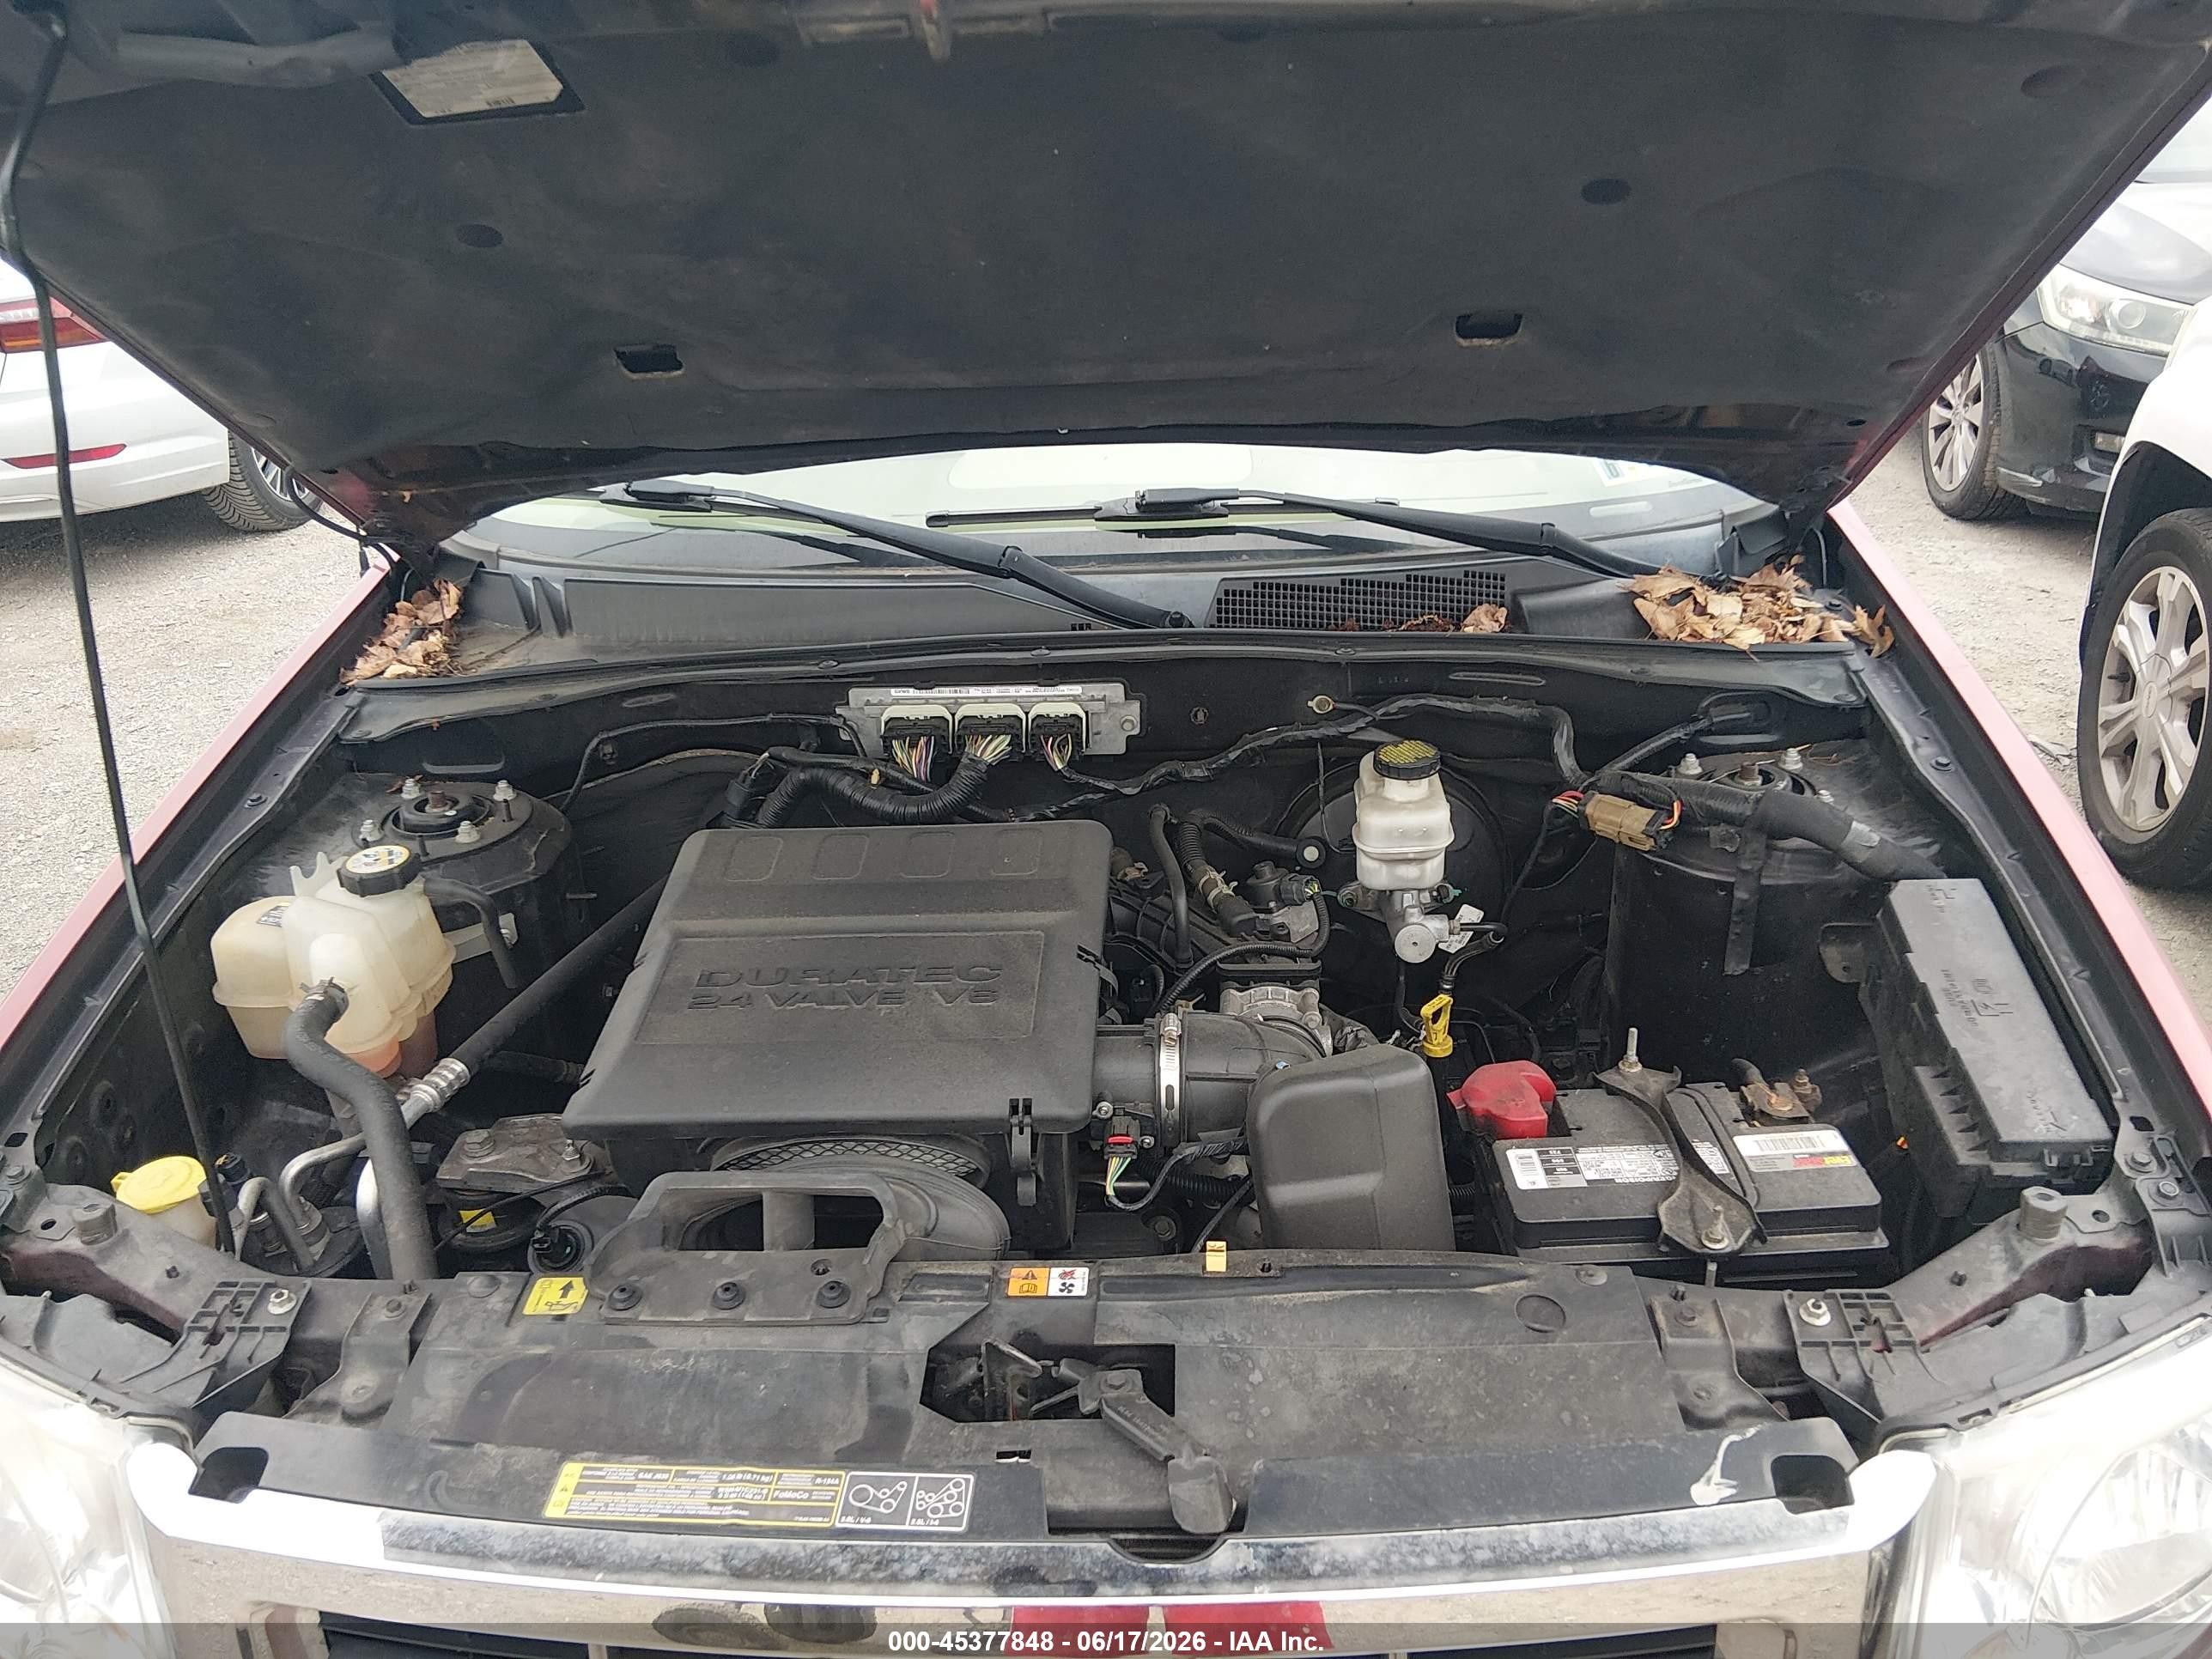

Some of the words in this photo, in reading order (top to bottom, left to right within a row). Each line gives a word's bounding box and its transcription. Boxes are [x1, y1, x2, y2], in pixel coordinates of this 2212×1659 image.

[695, 965, 1004, 988] DURATEC
[687, 992, 751, 1010] 24
[764, 989, 907, 1011] VALVE
[933, 986, 1000, 1007] V6
